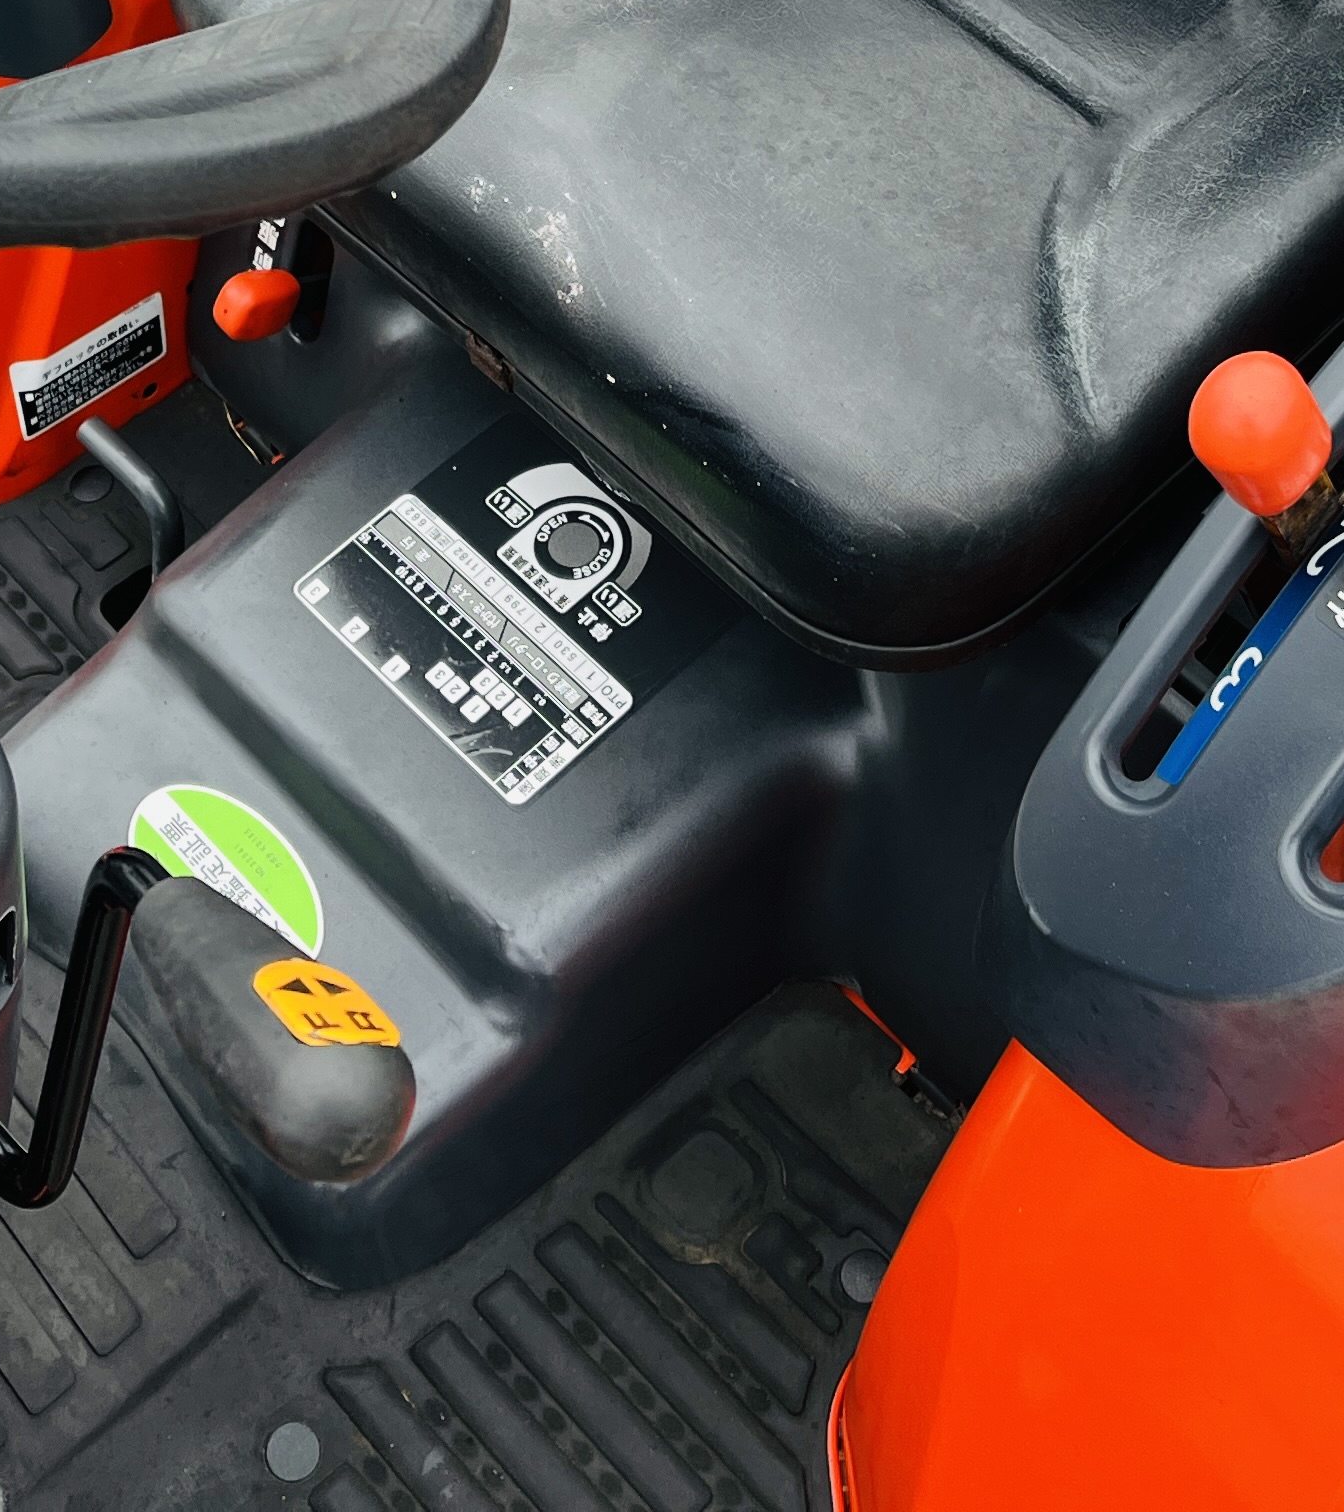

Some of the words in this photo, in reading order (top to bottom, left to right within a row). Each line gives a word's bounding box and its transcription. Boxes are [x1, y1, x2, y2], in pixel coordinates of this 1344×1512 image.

[536, 513, 567, 543] OPEN
[572, 547, 610, 581] CLOSE
[393, 564, 409, 579] 10
[500, 544, 571, 610] 落下速度調整
[403, 573, 416, 586] 9
[483, 575, 496, 588] 3
[308, 585, 320, 597] 3
[411, 581, 424, 594] 8
[423, 591, 436, 604] 7
[502, 592, 526, 615] 799
[435, 603, 448, 617] 6
[348, 622, 361, 635] 2
[448, 615, 460, 628] 5
[533, 620, 546, 634] 2
[574, 605, 614, 643] 停止
[460, 627, 473, 640] 4
[473, 638, 486, 651] 3
[551, 637, 578, 663] 530
[485, 649, 498, 663] 2
[432, 668, 446, 682] 3
[478, 674, 491, 688] 3
[585, 668, 597, 681] 1
[1210, 646, 1263, 712] 3
[447, 682, 461, 696] 2
[493, 688, 507, 702] 2
[599, 683, 627, 710] PTO
[469, 701, 482, 715] 1
[511, 705, 524, 718] 1
[304, 1012, 339, 1030] F
